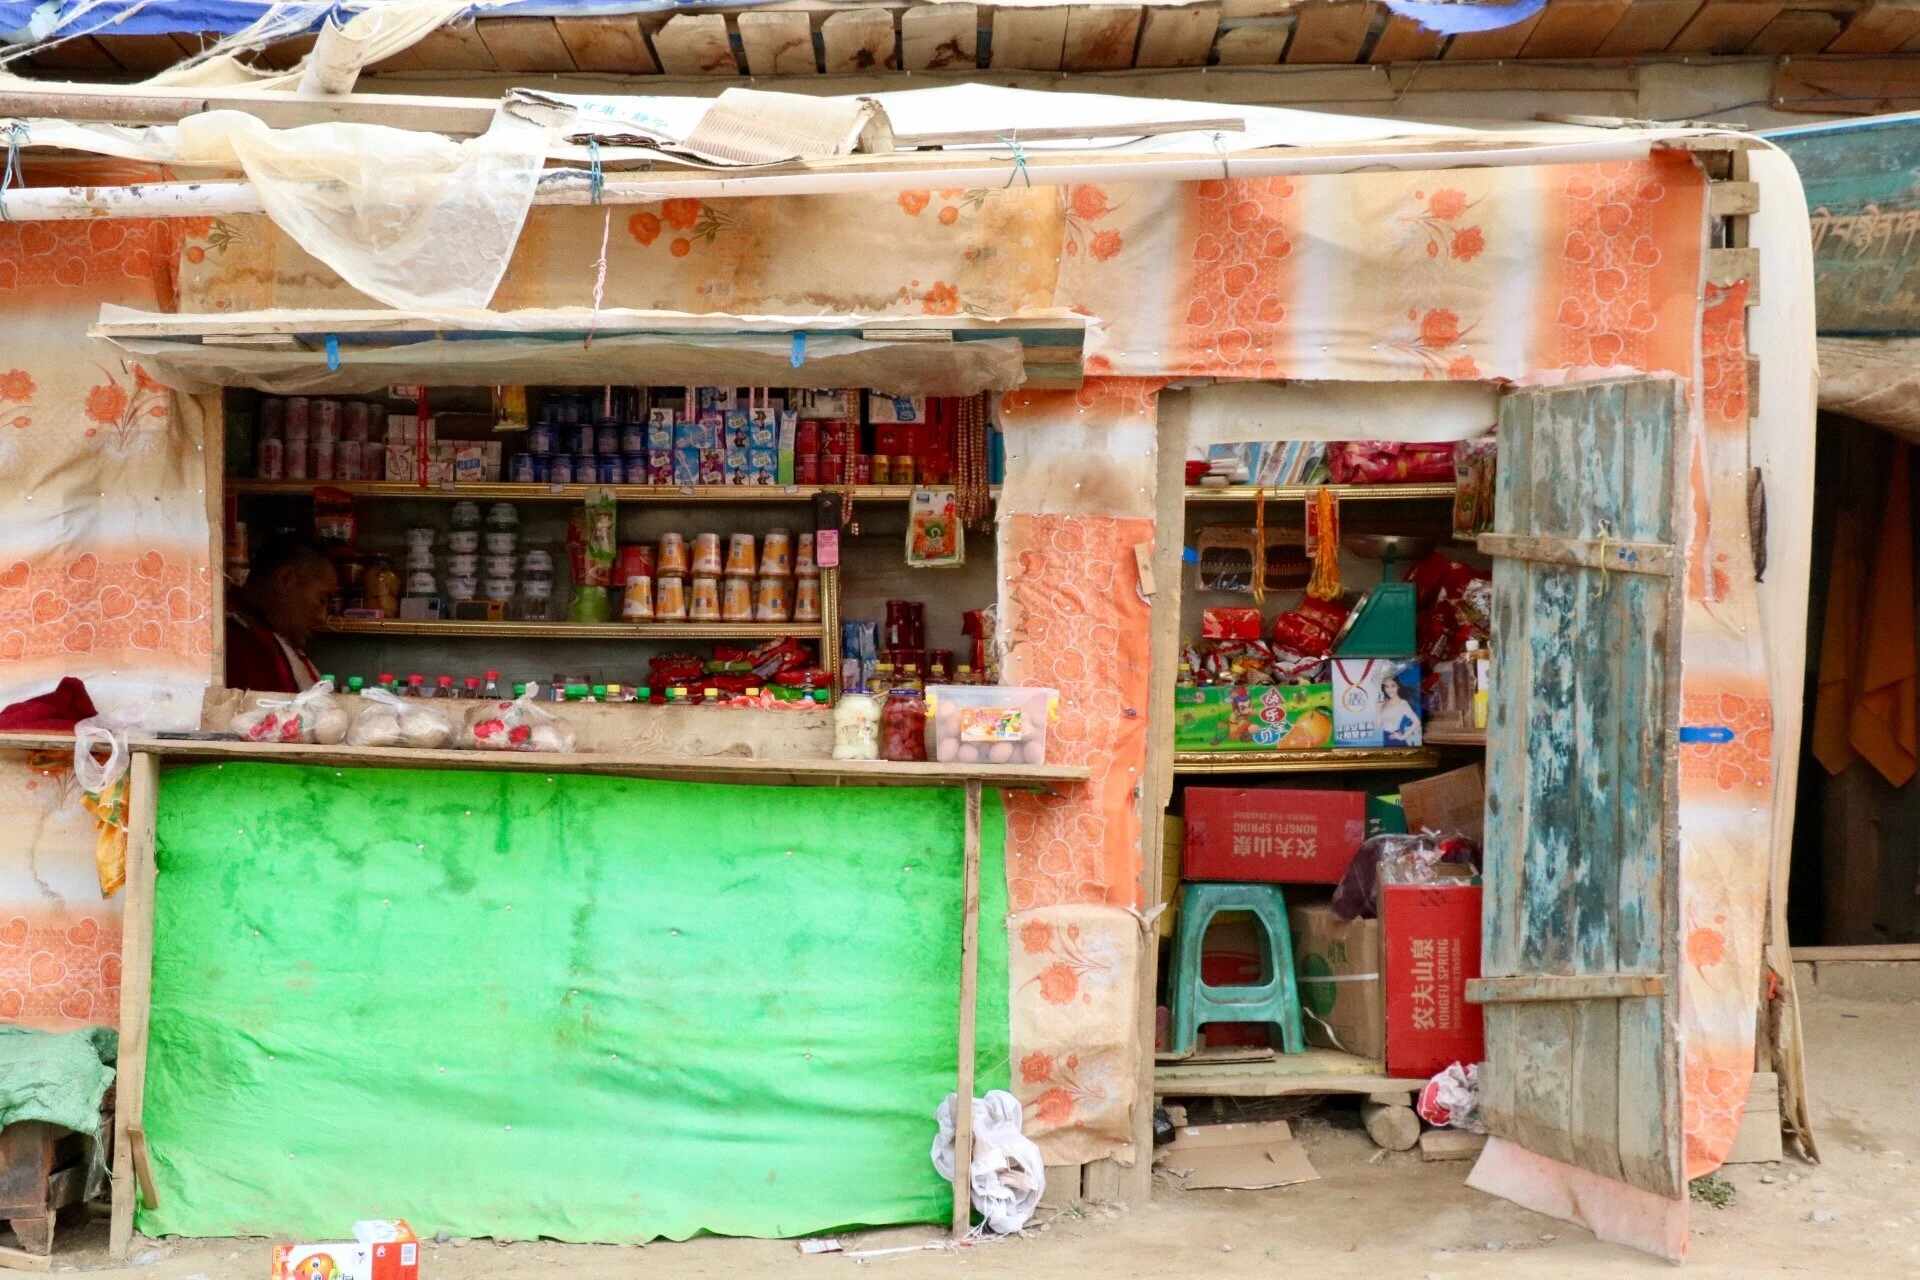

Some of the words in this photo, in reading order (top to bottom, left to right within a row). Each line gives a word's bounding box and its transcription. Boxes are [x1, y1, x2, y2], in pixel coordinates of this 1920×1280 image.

[1232, 822, 1272, 833] SPRING
[1276, 823, 1317, 834] NONGFU
[1232, 835, 1317, 858] 农夫山泉
[1437, 938, 1449, 980] SPRING
[1410, 938, 1435, 1030] 农夫山泉
[1438, 984, 1450, 1029] NONGFU
